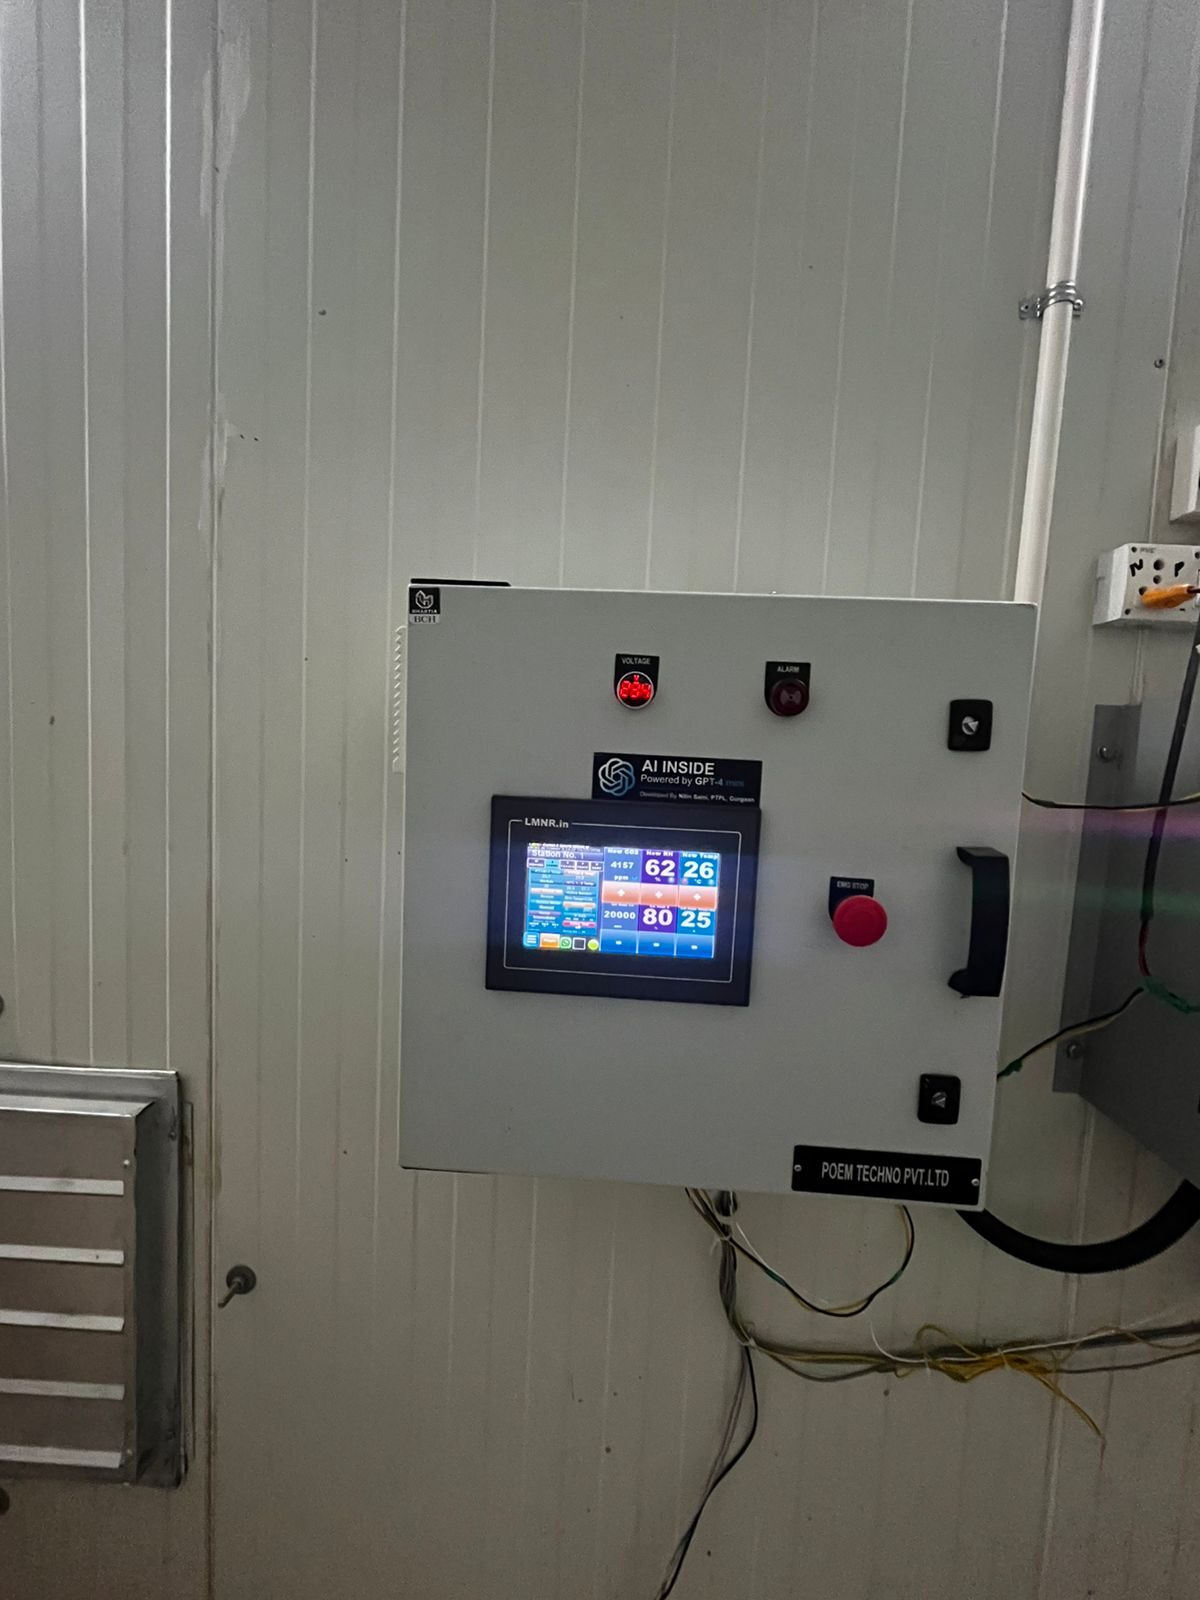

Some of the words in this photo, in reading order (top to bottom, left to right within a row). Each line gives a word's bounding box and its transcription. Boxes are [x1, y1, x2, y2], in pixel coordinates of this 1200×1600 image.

[414, 615, 436, 623] BCH
[642, 760, 658, 772] AI
[662, 760, 715, 776] INSIDE
[640, 774, 680, 784] Powered
[682, 776, 692, 787] by
[695, 777, 724, 786] GPT-4
[524, 818, 569, 828] LMNR.in
[610, 861, 634, 869] 4157
[645, 859, 676, 876] 62
[684, 861, 714, 878] 26
[604, 910, 636, 920] 20000
[643, 908, 672, 926] 80
[680, 911, 711, 928] 25
[822, 1162, 854, 1180] POEM
[856, 1164, 900, 1184] TECHNO
[904, 1168, 950, 1187] PVT.LTD
